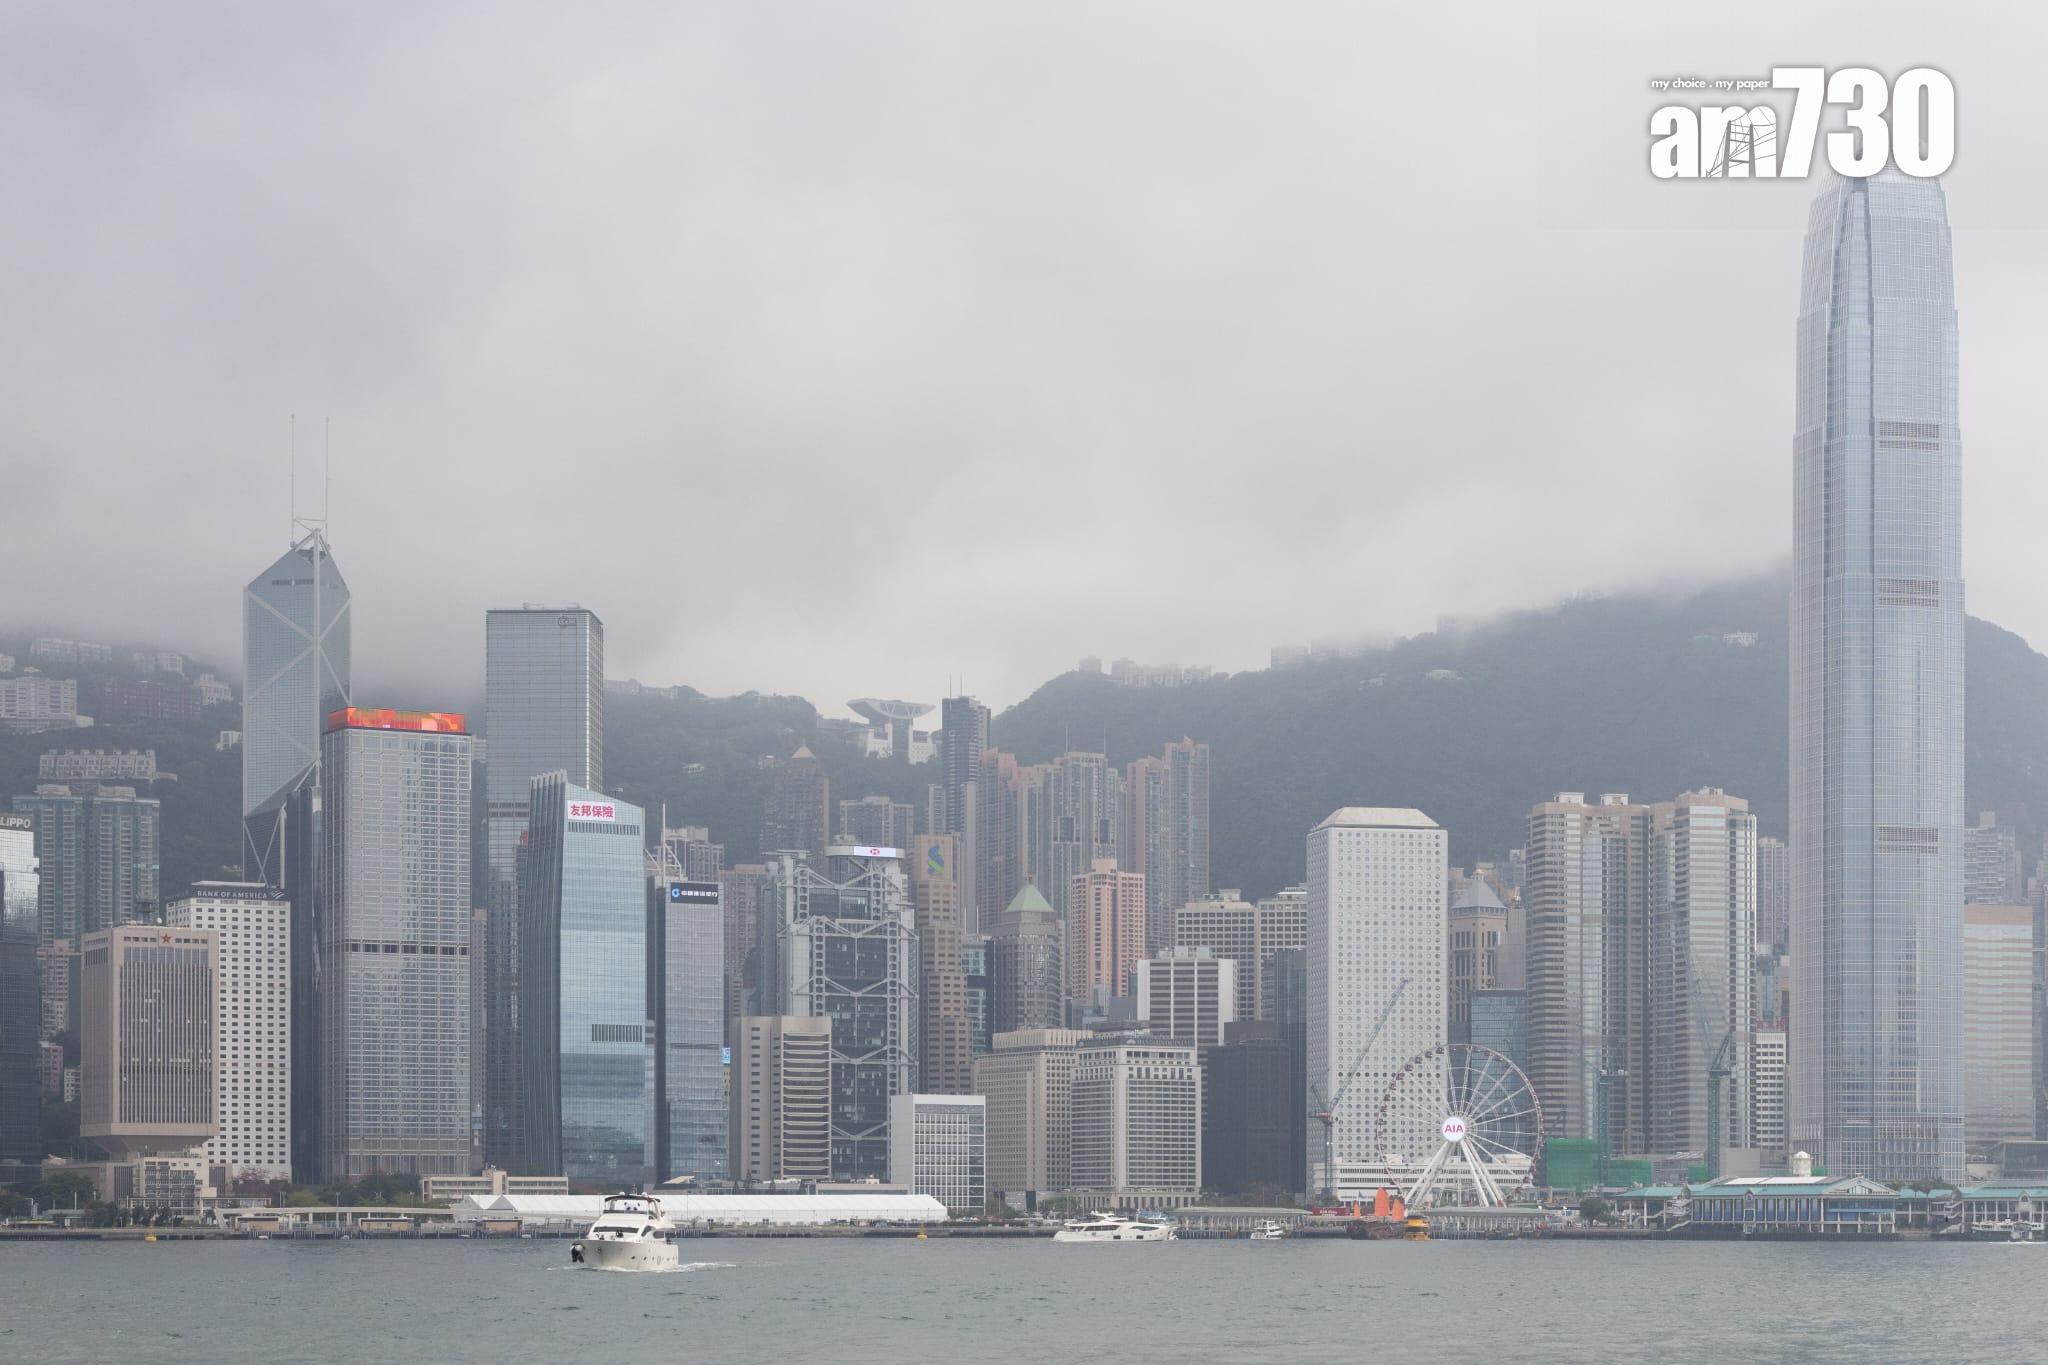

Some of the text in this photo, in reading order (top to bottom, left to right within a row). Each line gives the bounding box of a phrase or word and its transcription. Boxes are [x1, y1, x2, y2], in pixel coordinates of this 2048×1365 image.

[570, 804, 614, 818] 友邦保險
[0, 816, 31, 829] LIPPO
[232, 891, 268, 899] AMERICA
[1444, 1124, 1464, 1133] AIA
